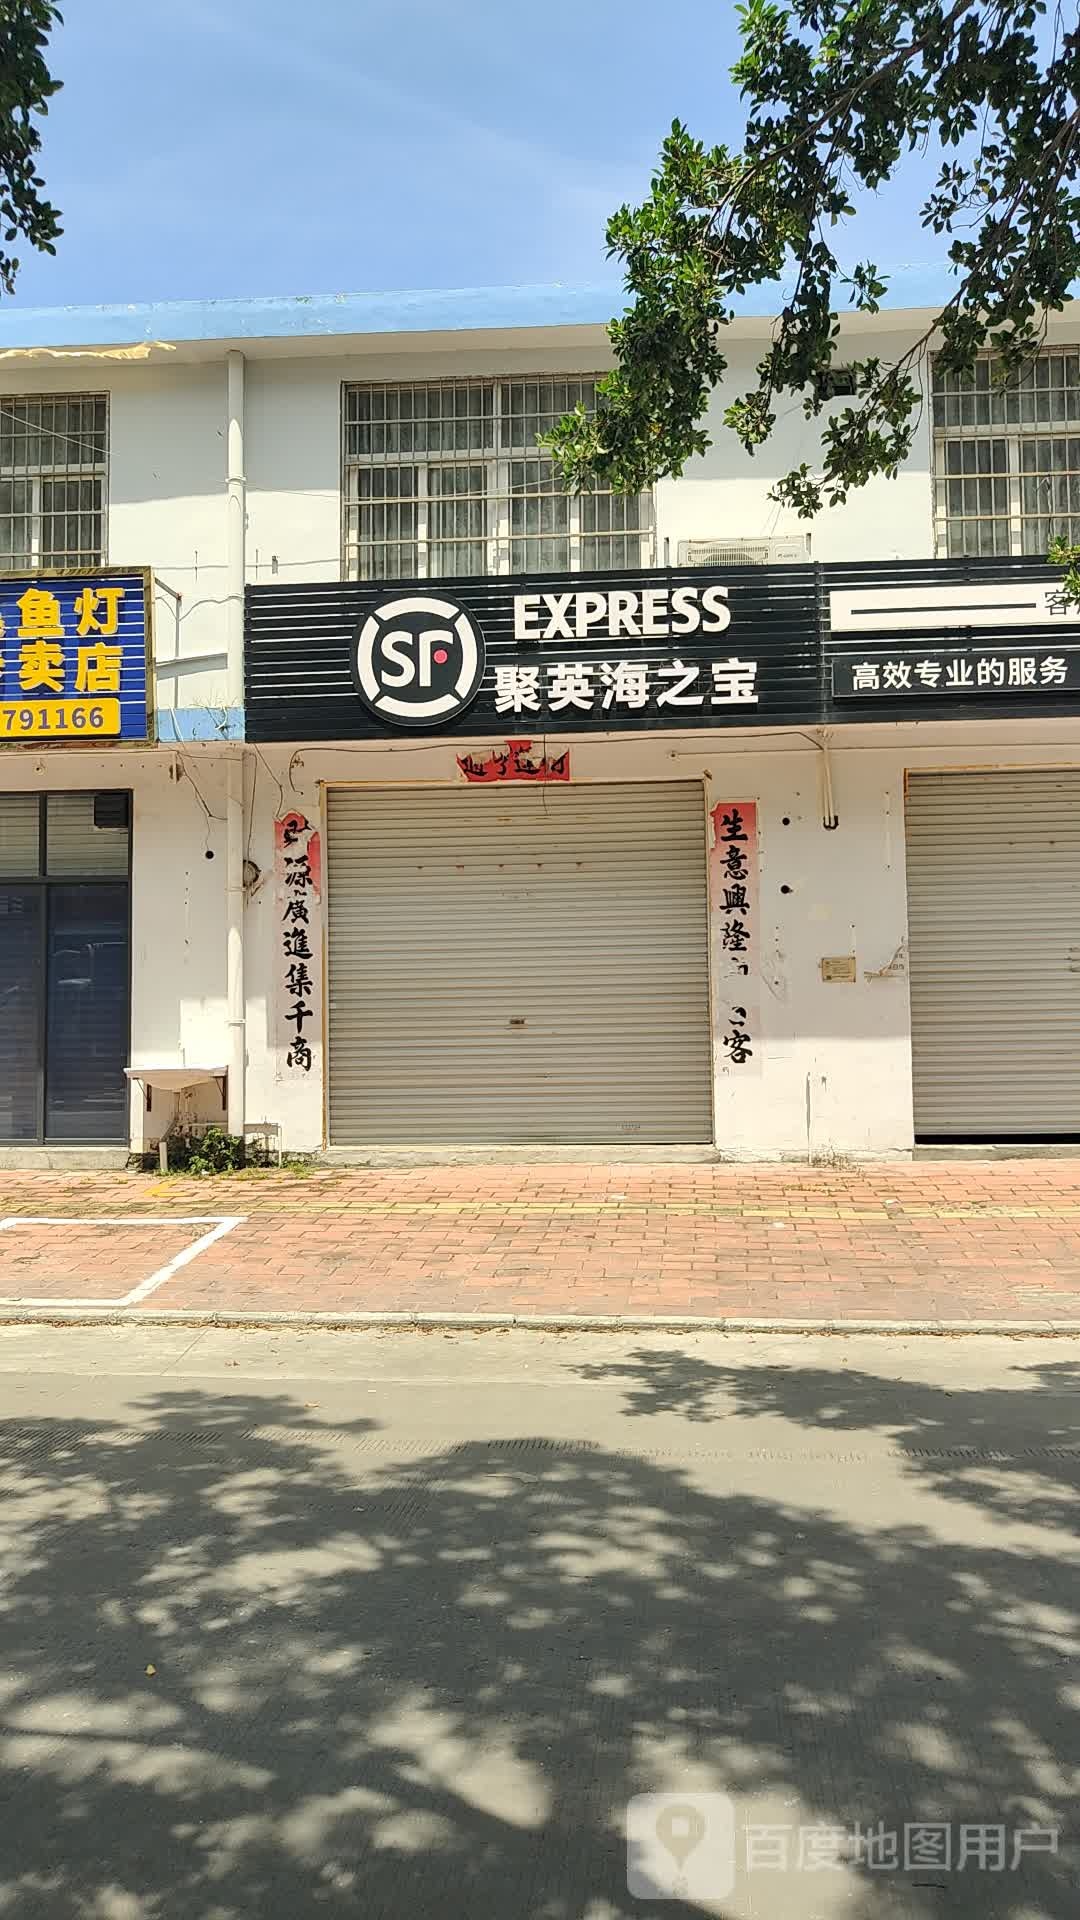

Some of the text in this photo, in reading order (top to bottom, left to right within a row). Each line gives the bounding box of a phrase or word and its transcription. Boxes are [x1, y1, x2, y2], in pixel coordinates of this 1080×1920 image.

[0, 587, 125, 638] 鱼灯
[513, 585, 732, 641] EXPRESS
[0, 640, 125, 693] 卖店
[380, 629, 455, 688] SF
[494, 657, 760, 713] 聚英海之宝
[851, 655, 1069, 691] 高效专业的服务
[2, 706, 105, 731] 791166
[719, 808, 753, 1064] 生意興隆客
